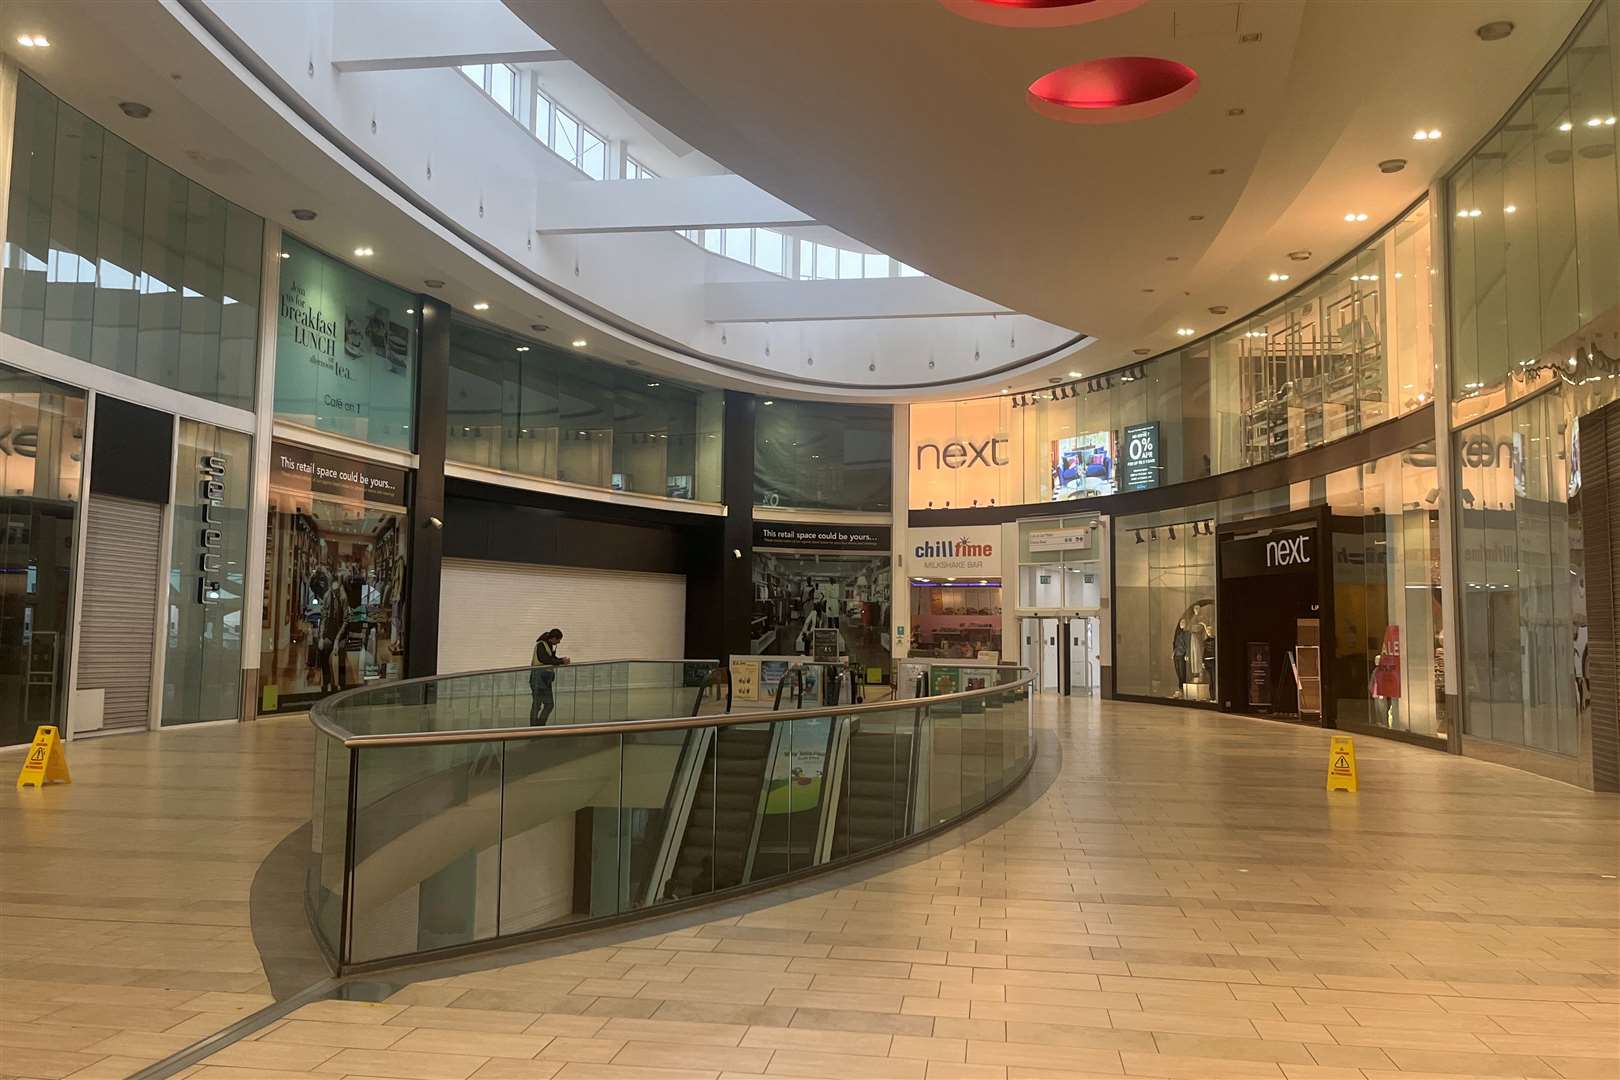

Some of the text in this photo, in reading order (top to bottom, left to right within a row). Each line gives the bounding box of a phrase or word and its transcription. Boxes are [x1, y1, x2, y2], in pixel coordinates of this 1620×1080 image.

[280, 294, 337, 338] breakfast
[294, 325, 336, 357] LUNCH
[916, 435, 1010, 471] next
[1129, 437, 1154, 460] 0%
[280, 456, 295, 470] This
[296, 461, 315, 474] retail
[316, 466, 338, 479] space
[339, 470, 358, 483] could
[359, 474, 369, 485] be
[370, 479, 396, 490] yours...
[763, 529, 777, 537] This
[777, 530, 795, 538] retail
[796, 532, 816, 540] space
[818, 532, 837, 540] could
[849, 535, 878, 544] yours...
[1265, 535, 1310, 567] next
[924, 560, 983, 569] MILKSHAKE BAR
